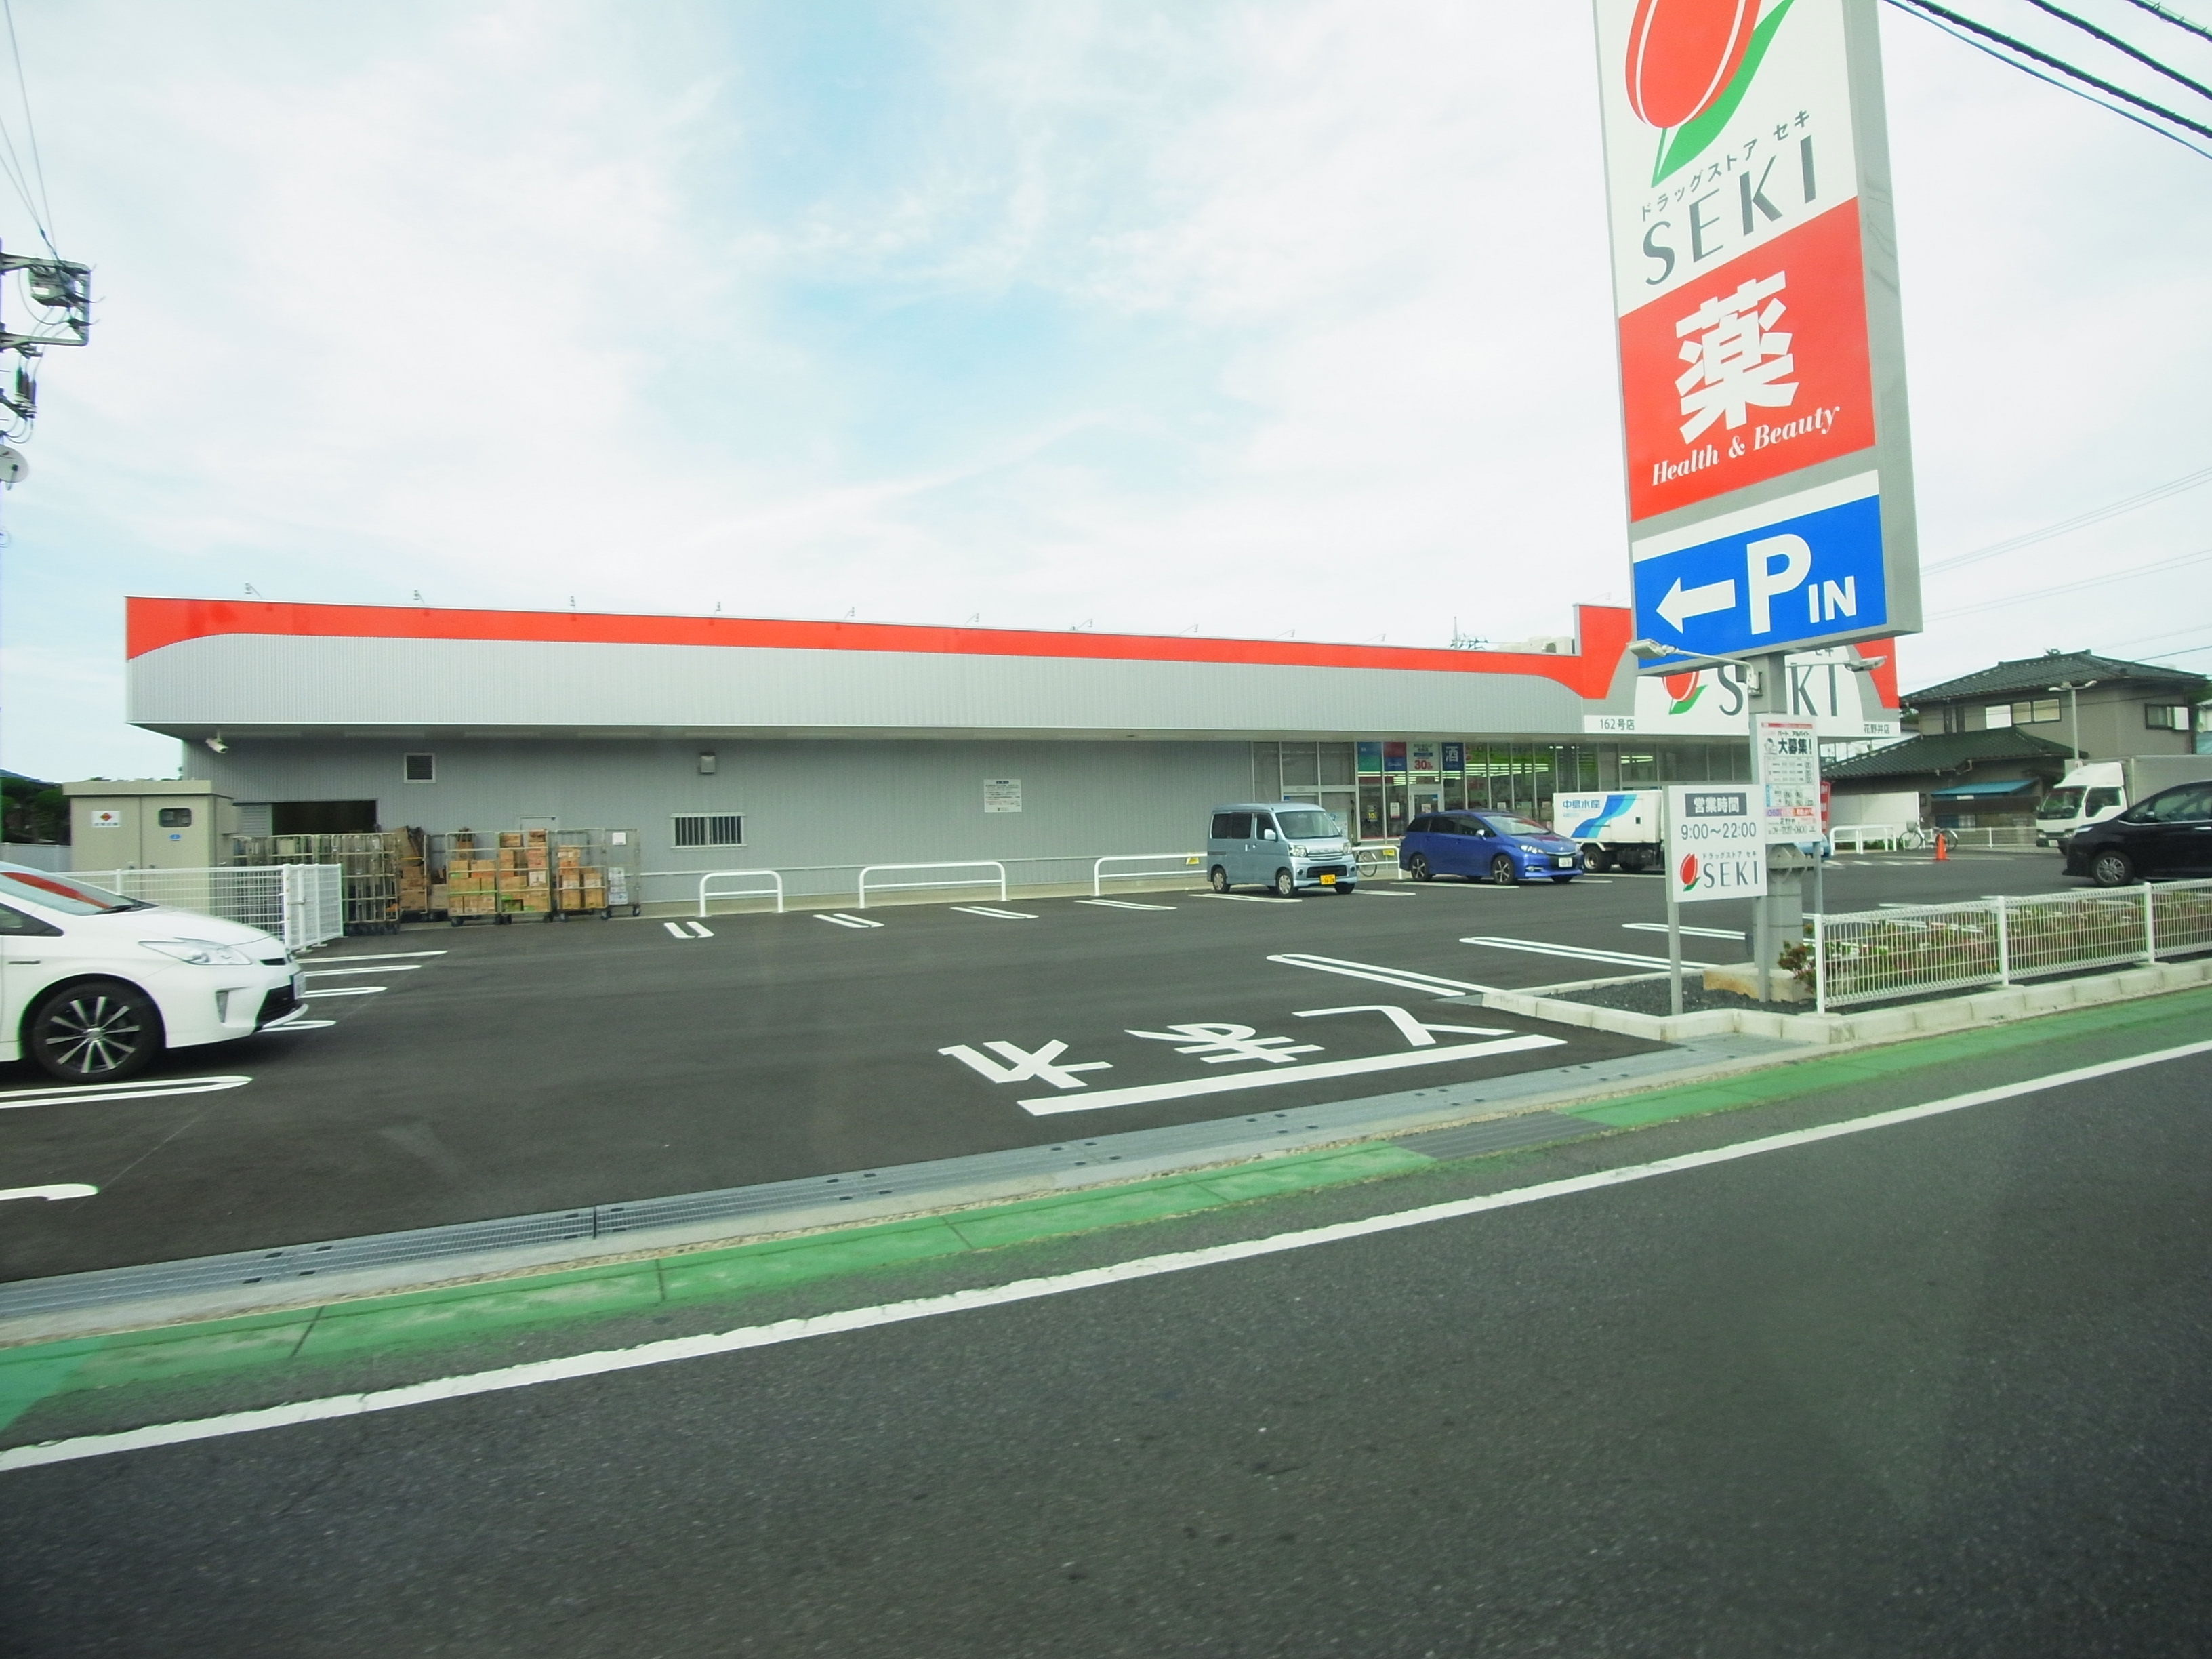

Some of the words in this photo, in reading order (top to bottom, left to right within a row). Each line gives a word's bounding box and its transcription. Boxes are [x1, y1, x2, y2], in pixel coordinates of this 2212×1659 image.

[1641, 138, 1758, 222] ドラッグストア
[1772, 110, 1810, 142] セキ
[1642, 135, 1817, 286] SEKI
[1675, 270, 1799, 445] 薬
[1652, 444, 1719, 486] Health
[1727, 436, 1746, 459] &
[1753, 406, 1841, 451] Beauty
[1717, 662, 1838, 716] SKI
[1600, 718, 1635, 731] 162号店
[1864, 724, 1890, 734] 花野井店
[1445, 746, 1459, 762] 酒
[1693, 796, 1740, 814] 営業時間
[1702, 851, 1742, 860] ドラッグストア
[1702, 861, 1759, 889] SEKI
